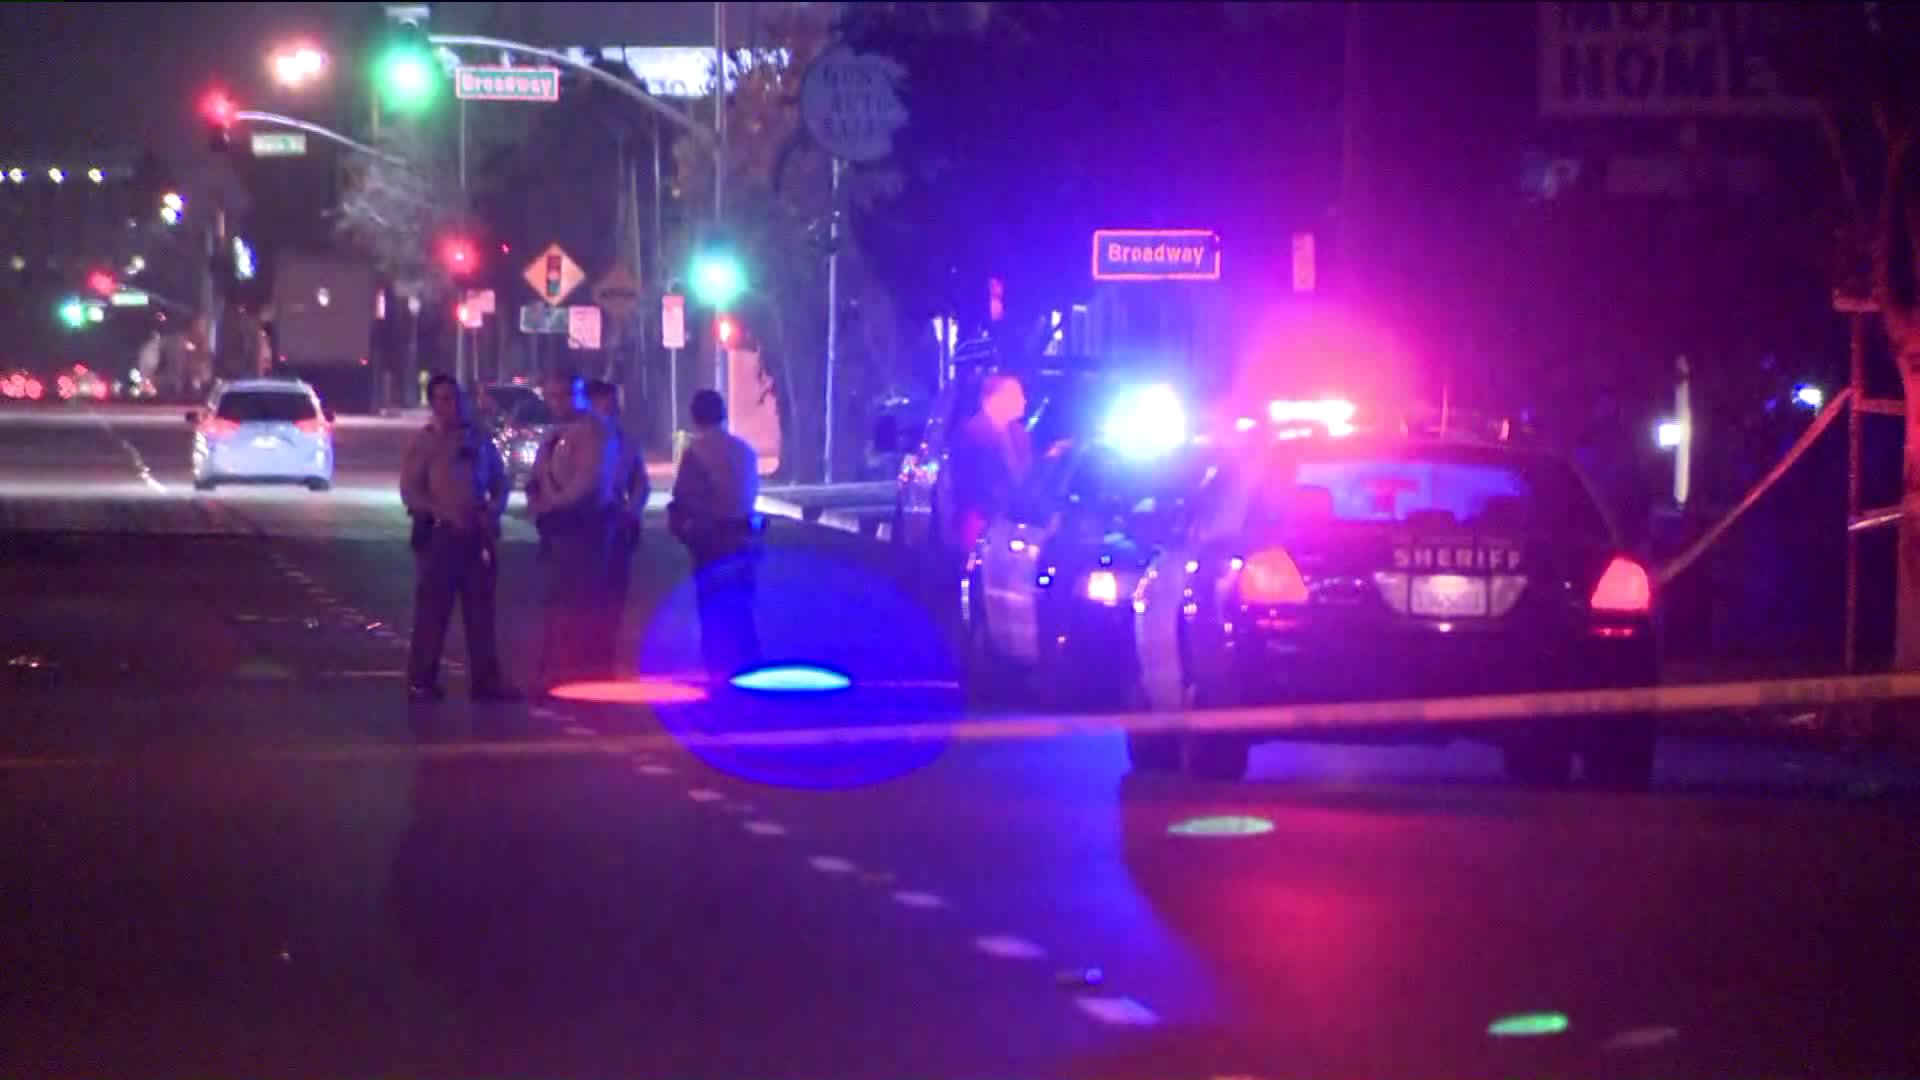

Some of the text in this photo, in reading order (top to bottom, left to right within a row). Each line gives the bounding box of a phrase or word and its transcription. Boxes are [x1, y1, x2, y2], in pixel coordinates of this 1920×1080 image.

[463, 73, 554, 96] Broadway
[1108, 242, 1205, 266] Broadway
[1393, 548, 1521, 570] SHERIFF
